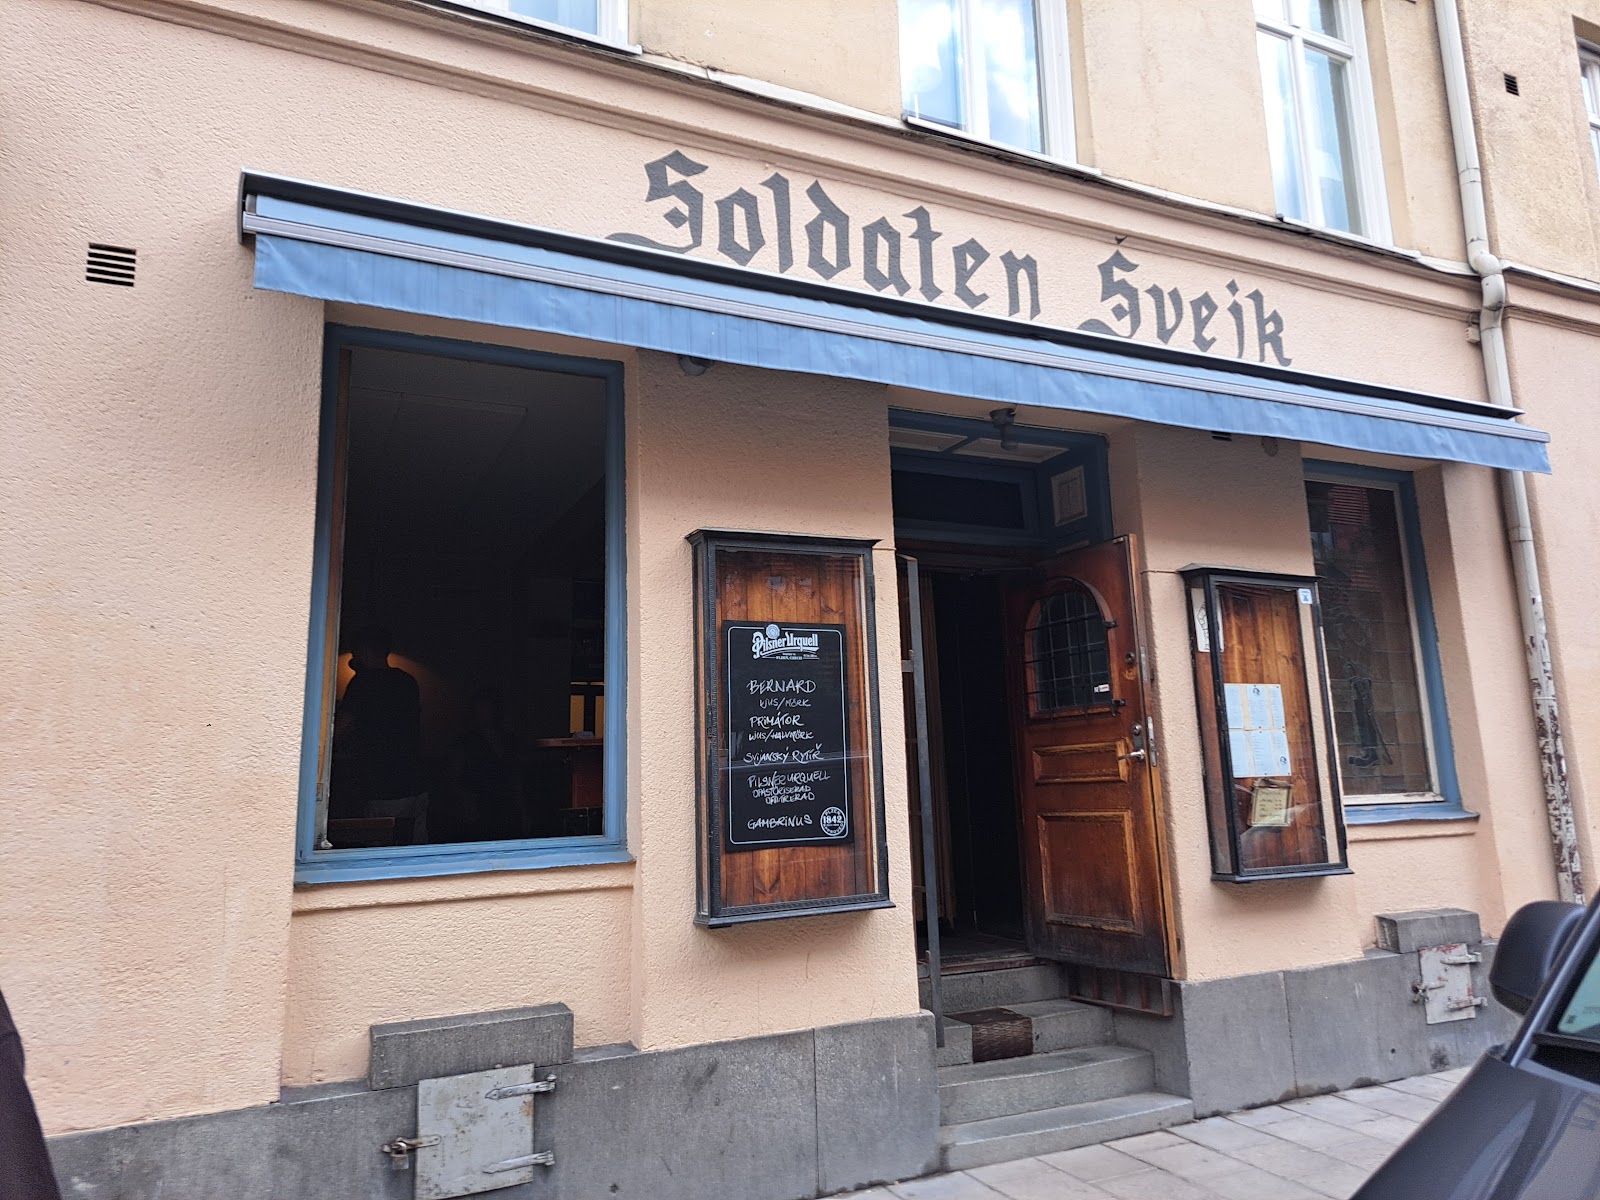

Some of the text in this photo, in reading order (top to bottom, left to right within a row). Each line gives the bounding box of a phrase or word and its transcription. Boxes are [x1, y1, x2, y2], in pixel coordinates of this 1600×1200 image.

[604, 149, 1040, 321] Soldaten
[752, 631, 819, 659] Pilsner Urquell
[746, 679, 816, 694] BERNARD
[787, 770, 831, 784] URQUELL
[823, 815, 842, 824] 1842
